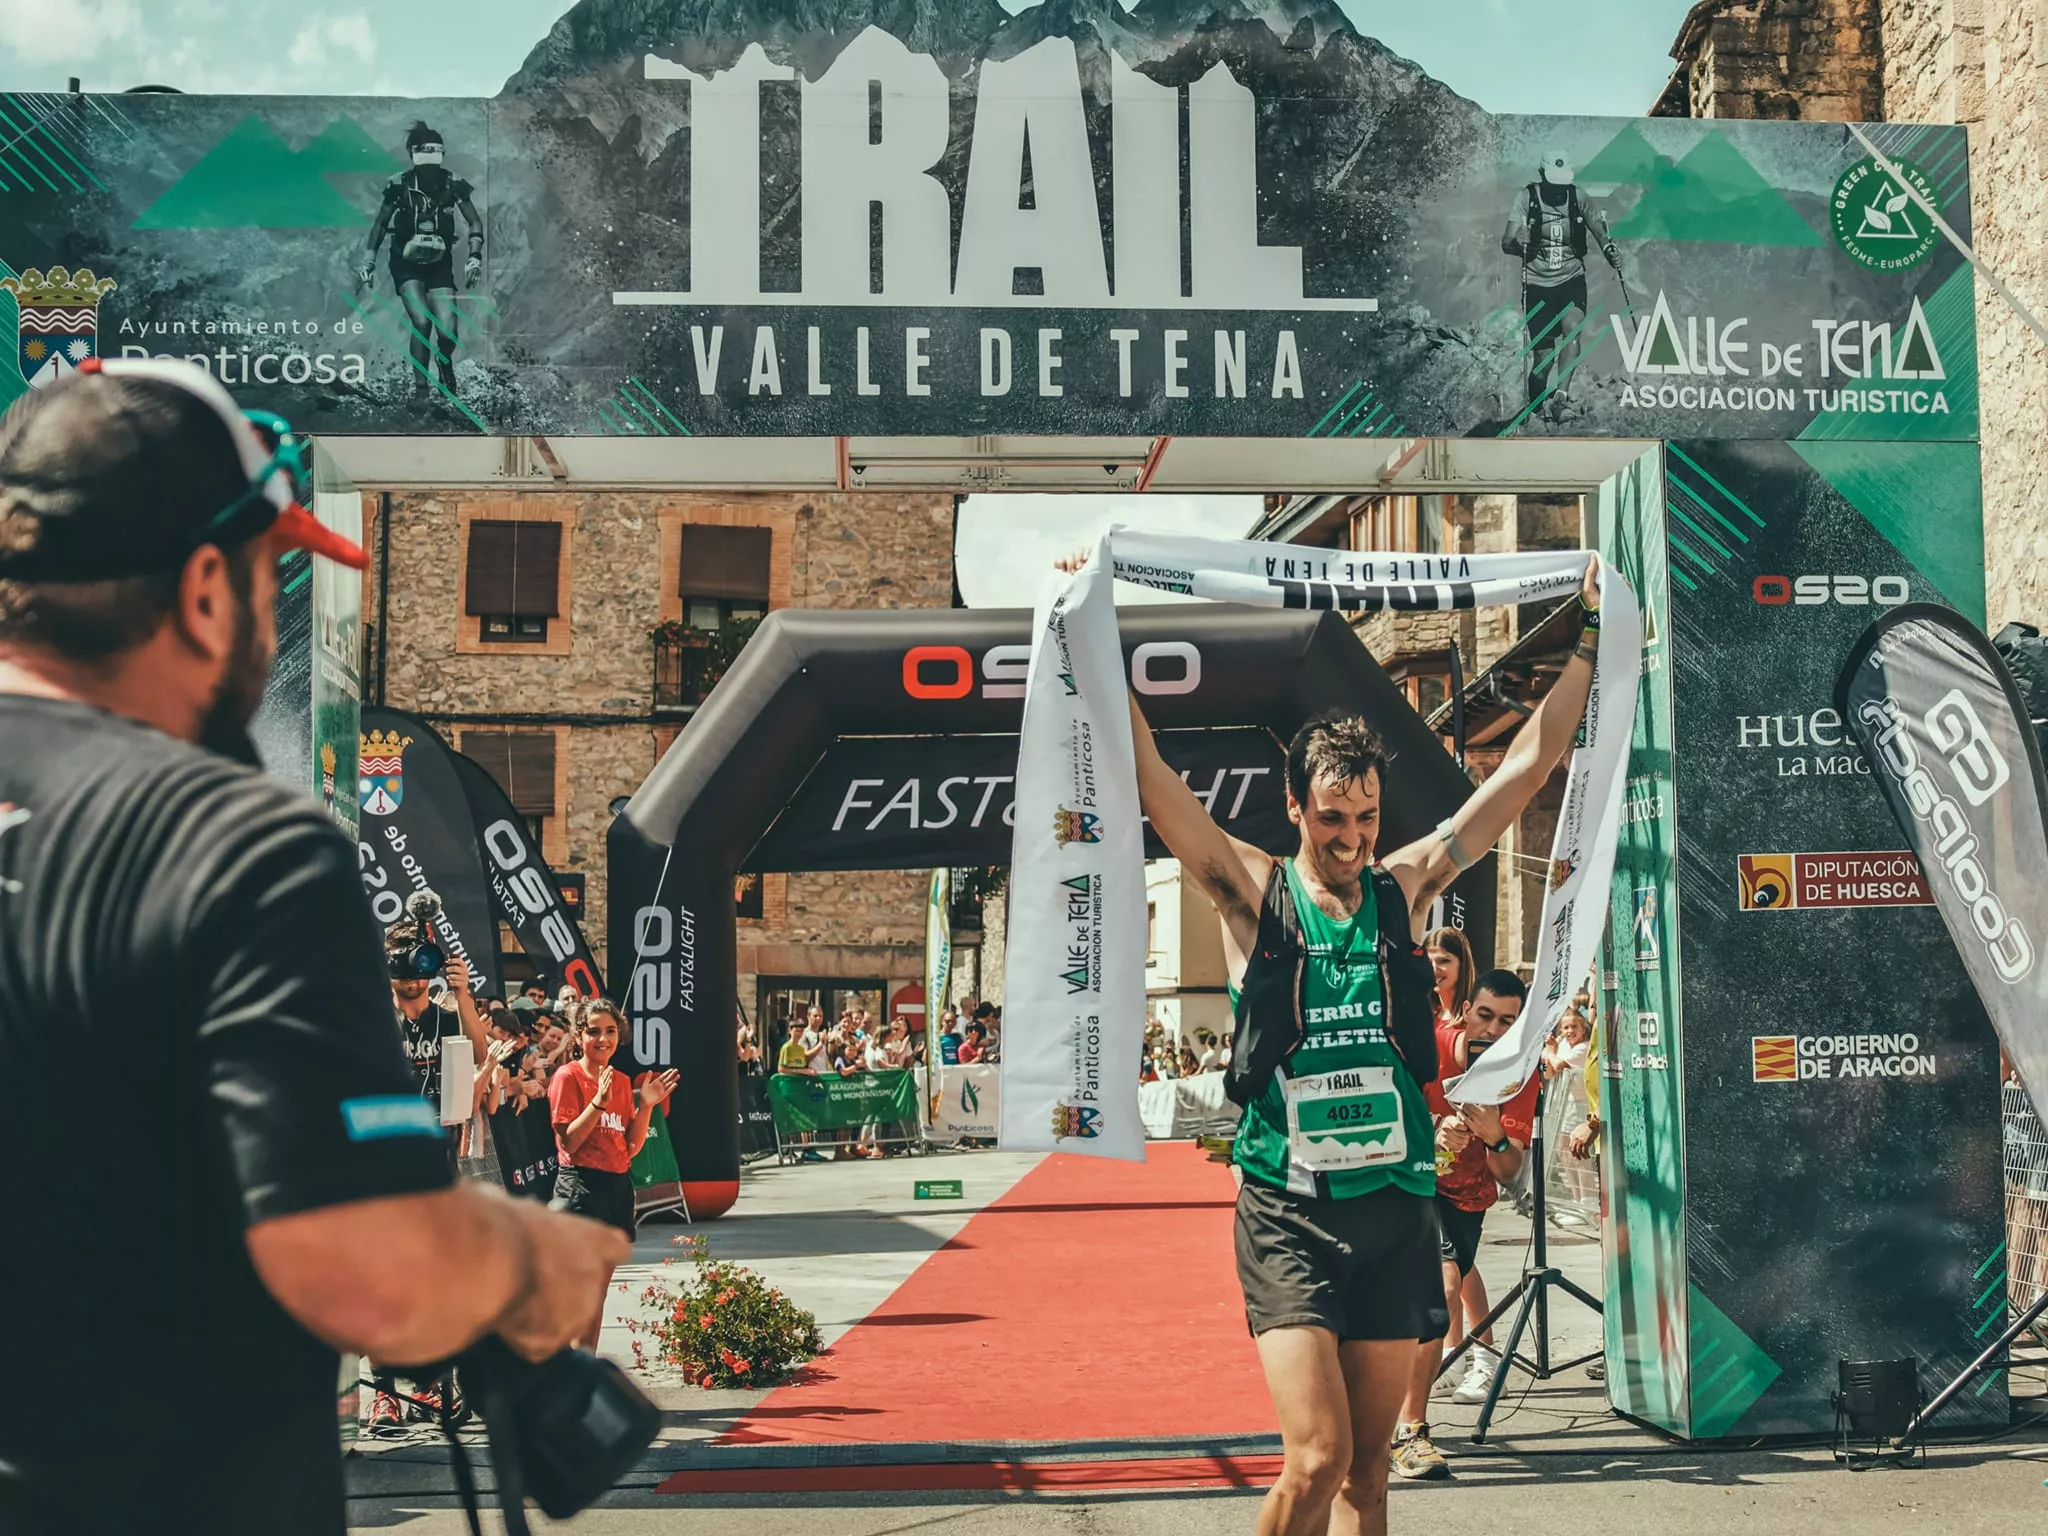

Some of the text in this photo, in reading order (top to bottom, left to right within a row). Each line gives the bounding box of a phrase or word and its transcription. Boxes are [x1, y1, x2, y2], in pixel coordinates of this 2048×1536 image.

[644, 24, 1304, 307] TRAIL
[1835, 165, 1868, 209] GREEN
[1874, 160, 1904, 177] CM
[119, 317, 365, 338] Ayuntamiento de
[1610, 288, 1947, 380] VALLE DE TENA
[121, 345, 366, 386] nticosa
[690, 325, 1304, 400] VALLE DE TENA
[1619, 385, 1950, 415] ASOCIACION TURISTICA
[1127, 563, 1195, 581] ASOCIACION
[1265, 556, 1470, 582] VALLE DE TENA
[902, 641, 1201, 700] OSO
[1073, 718, 1078, 731] de
[1082, 721, 1097, 808] Panticosa
[831, 767, 1270, 831] FASTHT
[1620, 795, 1664, 825] nticosa
[1804, 856, 1921, 880] DIPUTACIÓN
[1805, 880, 1921, 901] DE HUESCA
[1058, 874, 1091, 995] VALLE DE TENA
[1092, 873, 1103, 993] ASOCIACION TURISTICA
[680, 905, 696, 1012] FAST&LIGHT
[1306, 1003, 1364, 1024] ERRI
[1073, 1014, 1081, 1100] Ayuntamiento de
[1083, 1015, 1100, 1102] Panticosa
[1798, 1033, 1919, 1057] GOBIERNO
[1799, 1054, 1937, 1079] DE ARAGON
[830, 1092, 842, 1101] DE
[1326, 1073, 1364, 1091] TRAIL
[1327, 1103, 1373, 1121] 4032
